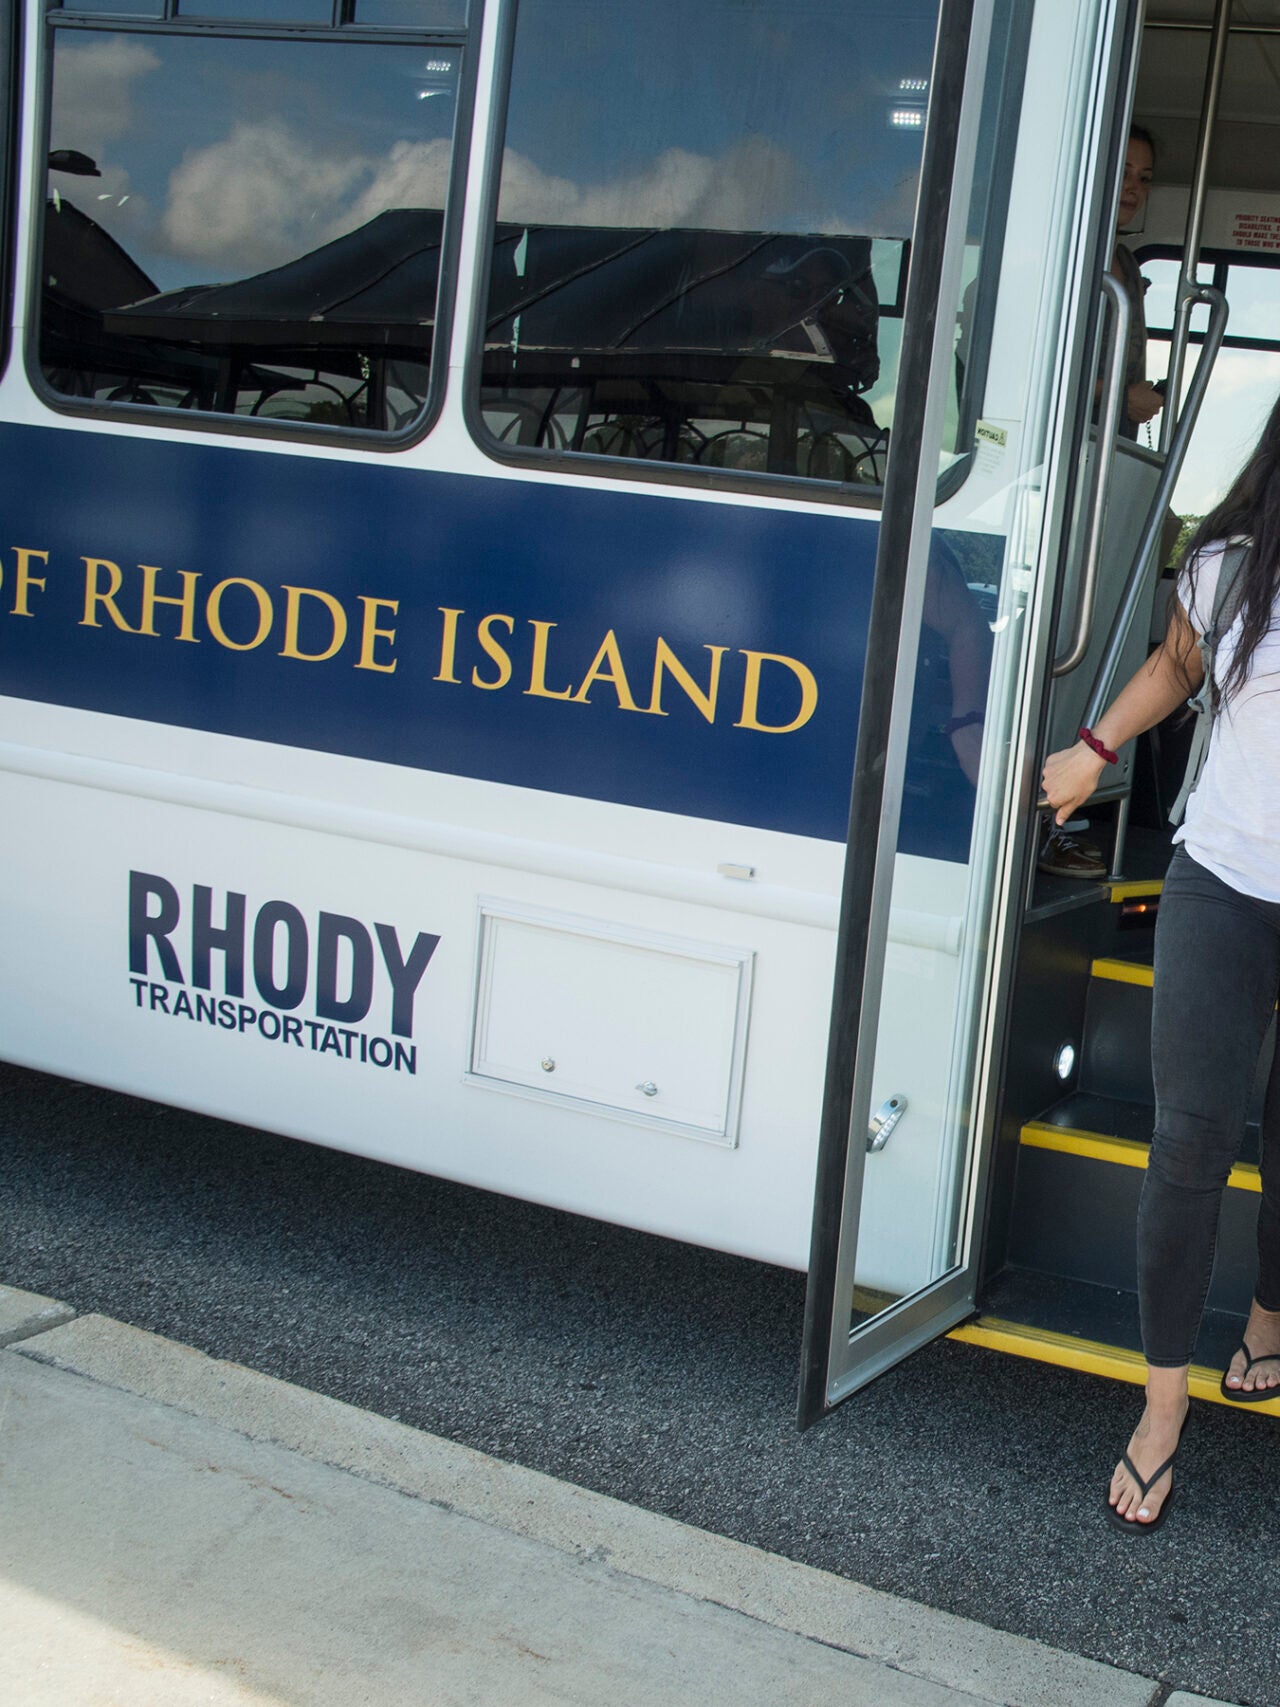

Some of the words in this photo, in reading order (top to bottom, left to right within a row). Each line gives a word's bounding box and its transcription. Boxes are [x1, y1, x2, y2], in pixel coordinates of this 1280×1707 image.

[1232, 230, 1251, 238] SHOULD
[1235, 214, 1259, 222] PRIORITY
[1260, 216, 1280, 224] SEATING
[1236, 238, 1243, 246] TO
[1244, 239, 1260, 247] THOSE
[0, 546, 49, 617] F
[78, 556, 400, 674] RHODE
[432, 607, 818, 734] ISLAND
[129, 870, 442, 1039] RHODY
[129, 977, 417, 1075] TRANSPORTATION
